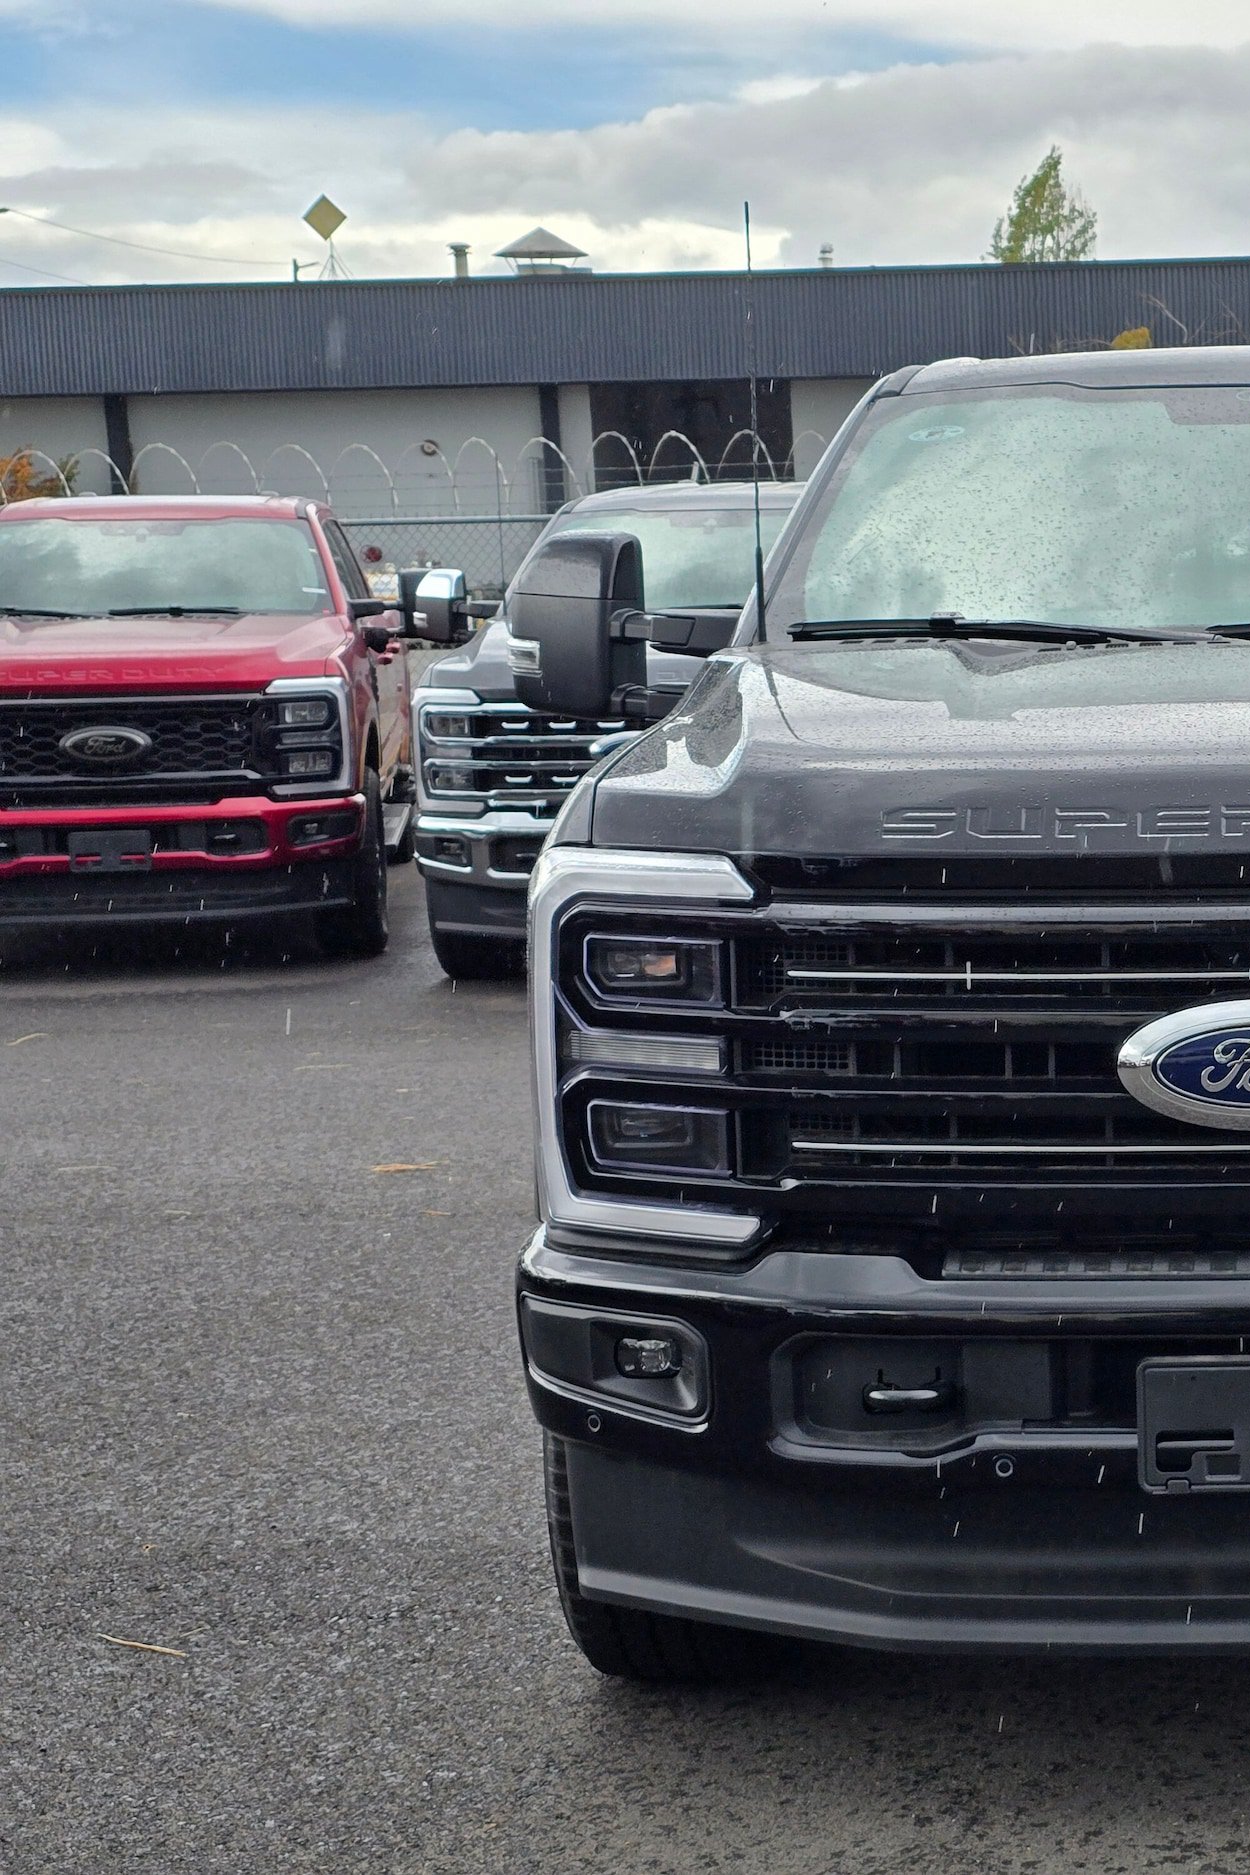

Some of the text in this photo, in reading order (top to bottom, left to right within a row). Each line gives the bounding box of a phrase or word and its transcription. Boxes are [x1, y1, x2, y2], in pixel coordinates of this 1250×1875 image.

[0, 667, 225, 682] UPER DUTY
[84, 736, 127, 754] Ford
